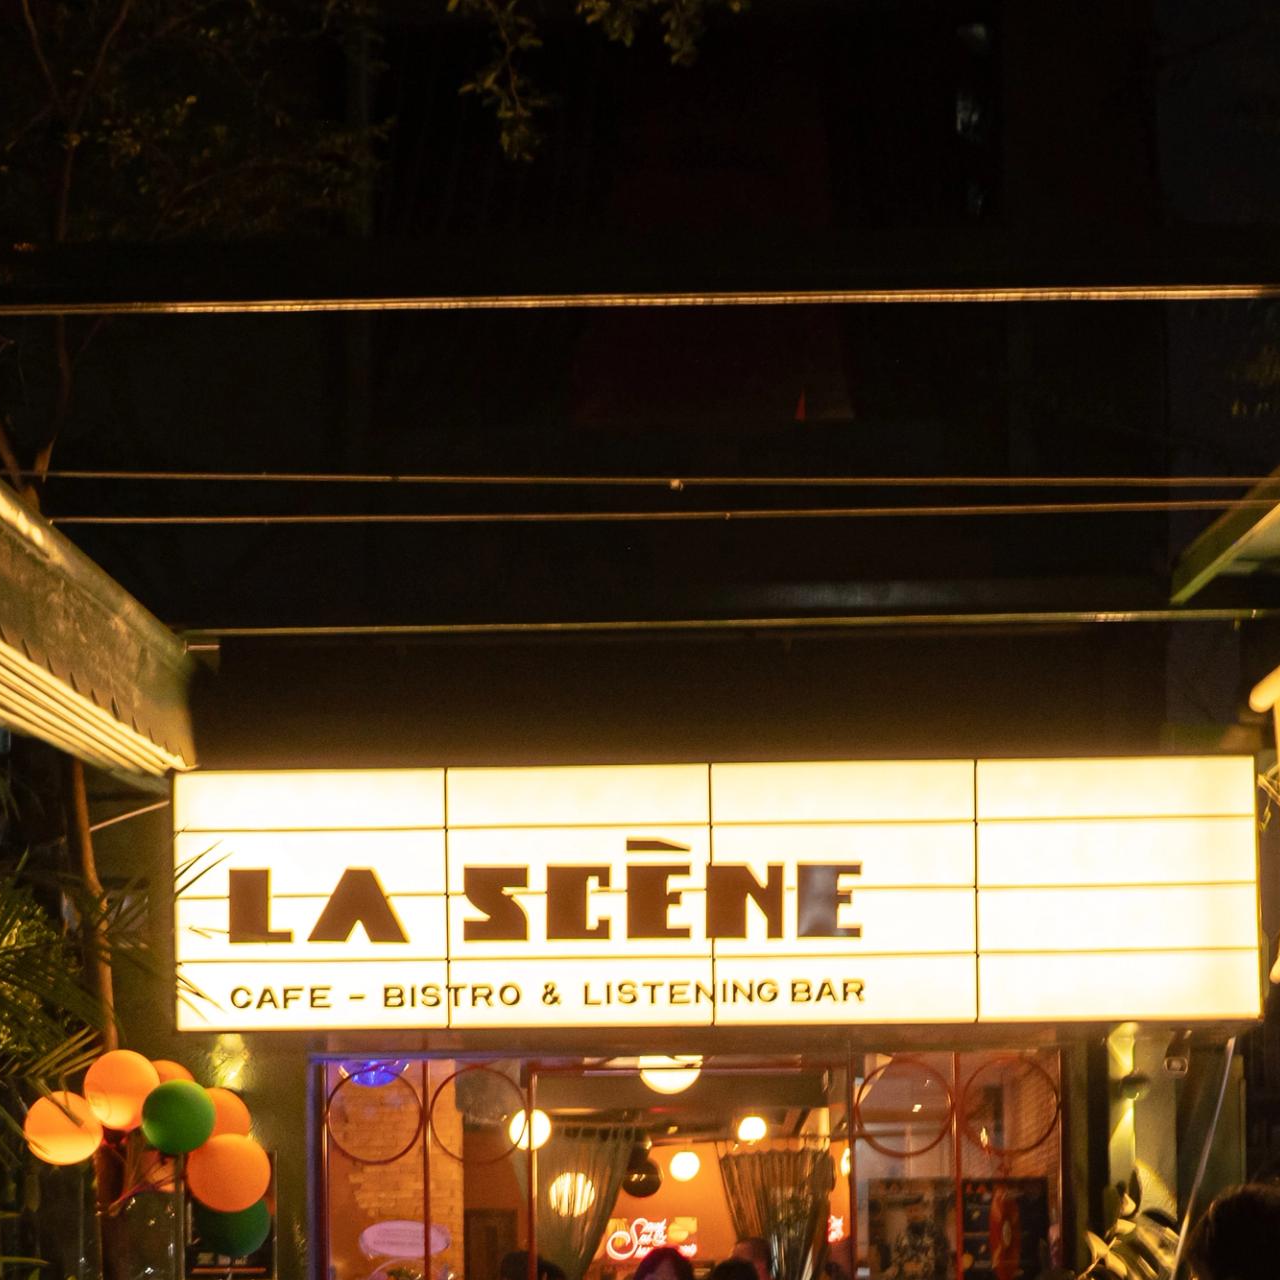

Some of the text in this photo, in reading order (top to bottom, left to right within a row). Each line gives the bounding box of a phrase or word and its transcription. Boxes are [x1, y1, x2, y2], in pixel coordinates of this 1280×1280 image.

[229, 836, 863, 943] LA SCÈNE
[229, 985, 332, 1010] CAFE
[382, 983, 522, 1009] BISTRO
[540, 983, 561, 1006] &
[583, 979, 780, 1006] LISTENING
[791, 977, 867, 1005] BAR
